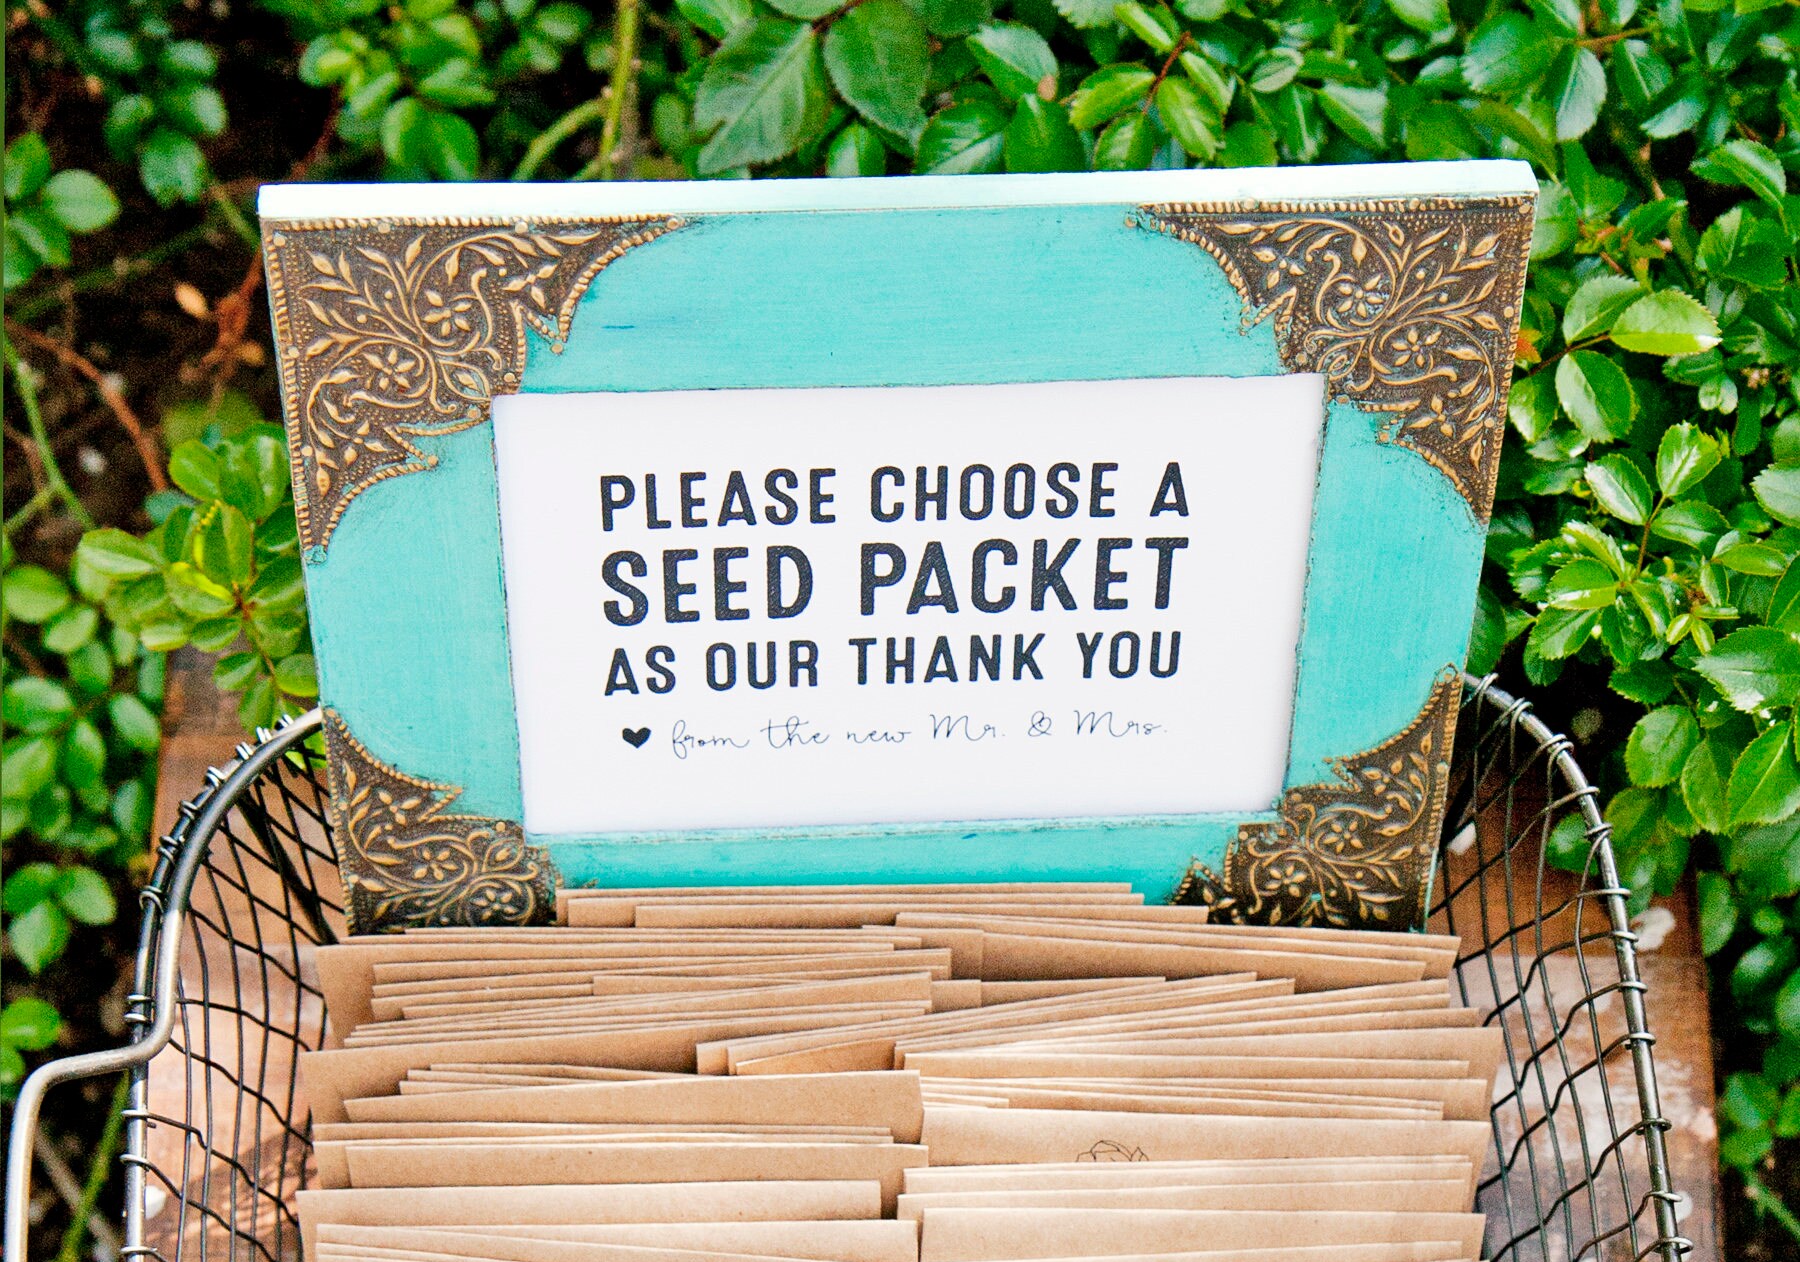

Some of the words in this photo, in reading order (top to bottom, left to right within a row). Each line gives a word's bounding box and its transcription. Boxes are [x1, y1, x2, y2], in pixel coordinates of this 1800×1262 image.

[601, 468, 836, 531] PLEASE
[871, 462, 1118, 522] CHOOSE
[1150, 462, 1189, 517] A
[602, 545, 813, 626] SEED
[861, 537, 1189, 616] PACKET
[605, 645, 676, 696] AS
[706, 640, 818, 691] OUR
[849, 633, 1045, 685] THANK
[1077, 631, 1181, 678] YOU
[672, 719, 750, 760] from
[760, 715, 830, 748] the
[846, 729, 912, 745] new
[929, 712, 1005, 742] Mr.
[1027, 711, 1052, 738] &
[1073, 709, 1168, 738] Mrs.
